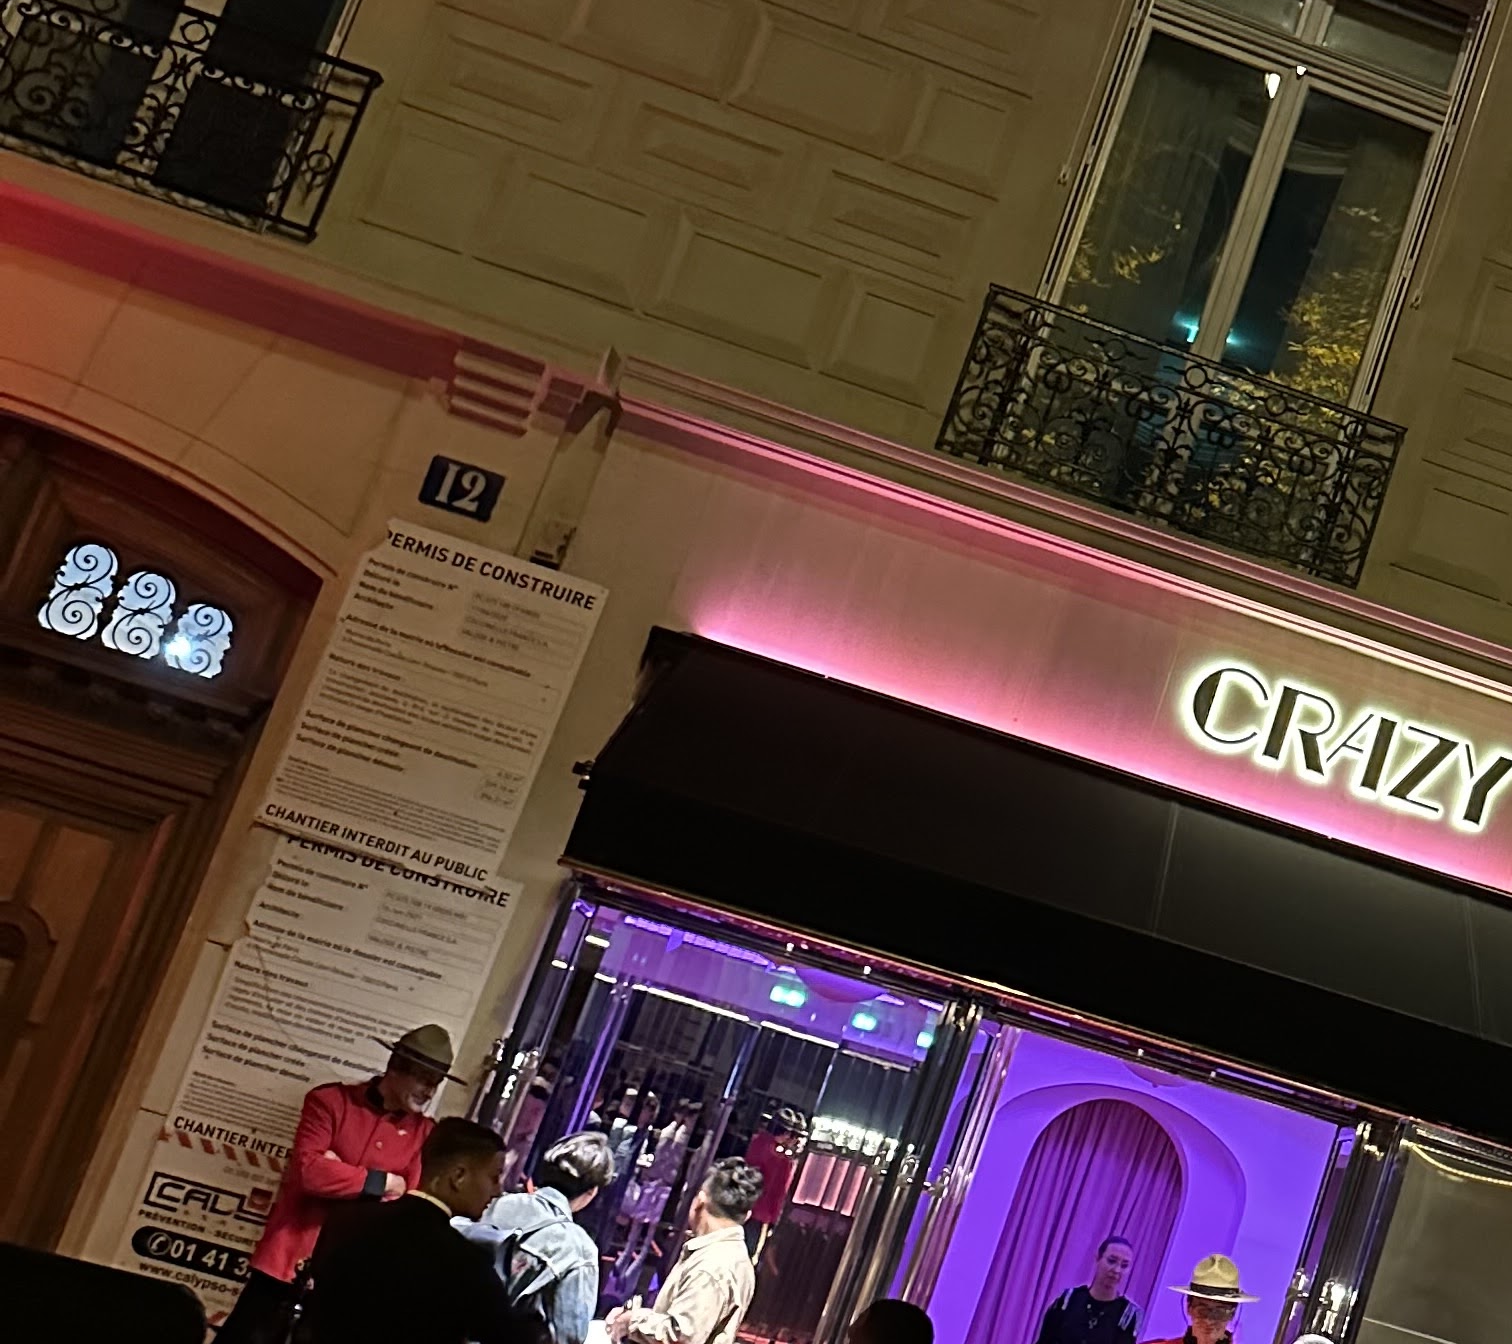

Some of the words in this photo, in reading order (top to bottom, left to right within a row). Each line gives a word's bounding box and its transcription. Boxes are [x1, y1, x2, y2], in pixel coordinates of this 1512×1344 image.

[435, 462, 486, 512] 12
[451, 551, 476, 574] DE
[479, 560, 597, 611] CONSTRUIRE
[265, 803, 340, 842] CHANTIER
[341, 826, 411, 859] INTERDIT
[410, 848, 435, 866] AU
[434, 855, 488, 882] PUBLIC
[173, 1115, 249, 1150] CHANTIER
[138, 1262, 240, 1297] www.calypso-s
[169, 1239, 198, 1262] 01
[201, 1248, 230, 1271] 41
[233, 1257, 251, 1280] 3
